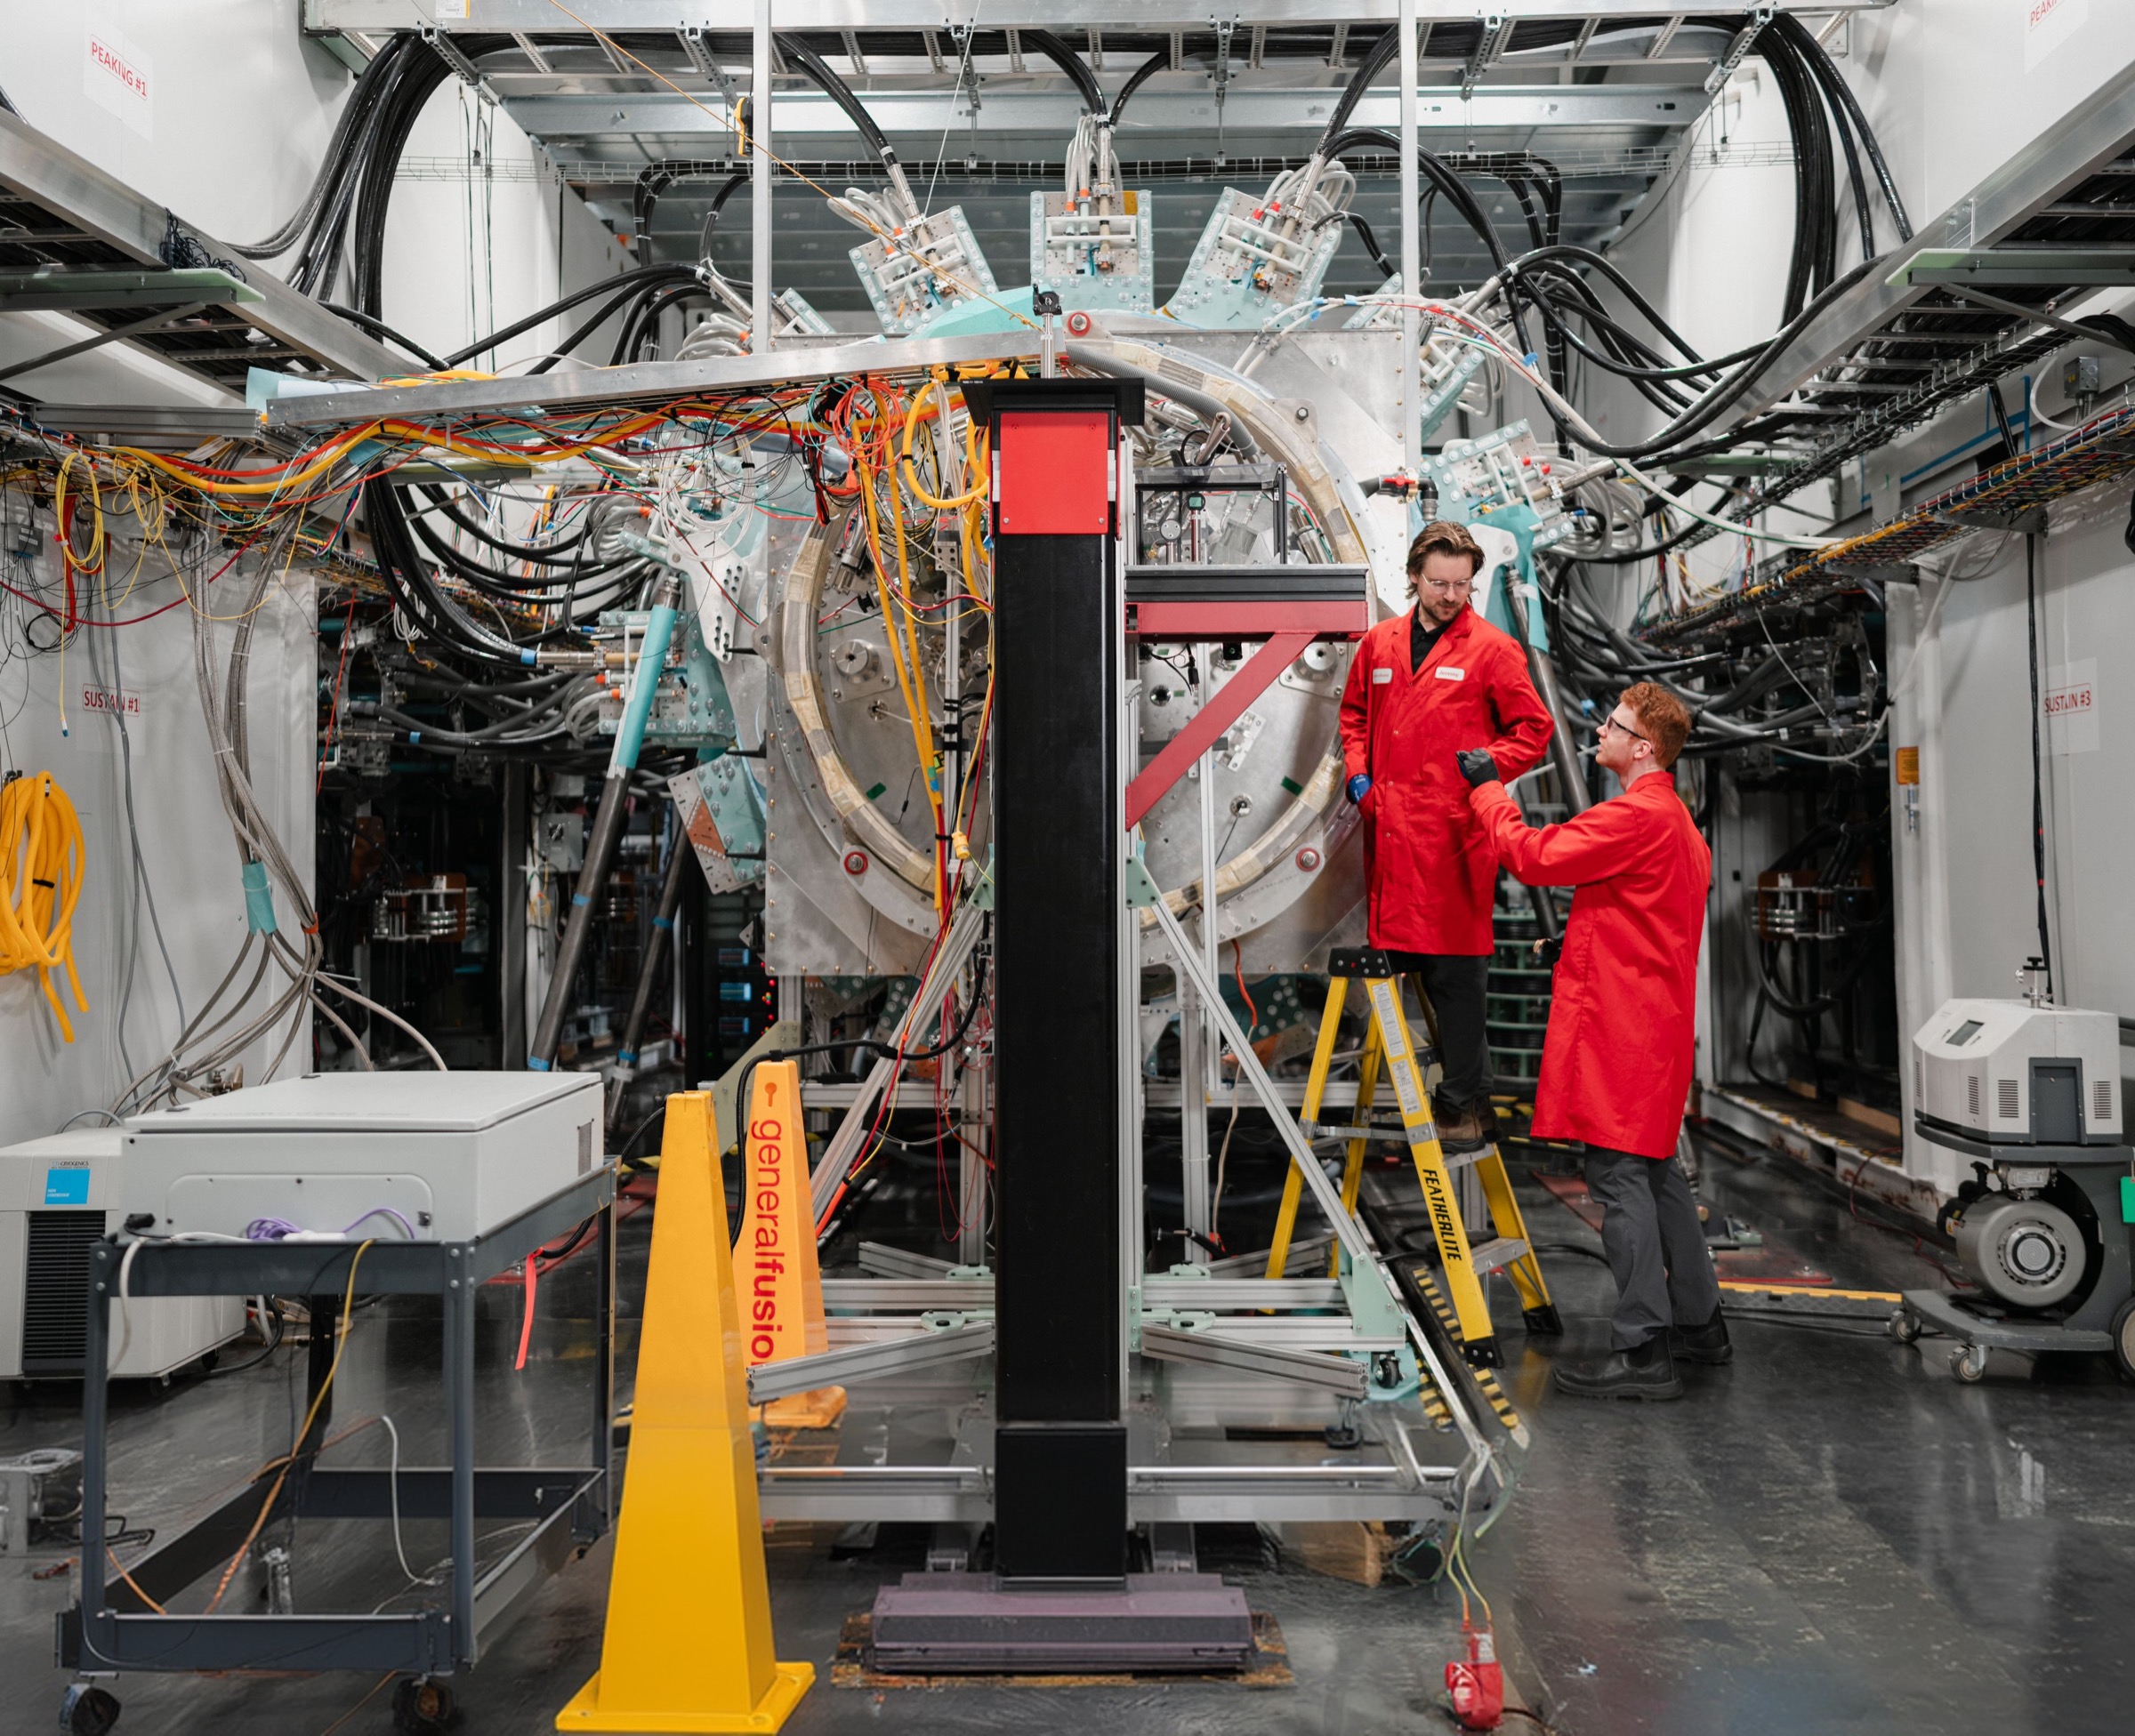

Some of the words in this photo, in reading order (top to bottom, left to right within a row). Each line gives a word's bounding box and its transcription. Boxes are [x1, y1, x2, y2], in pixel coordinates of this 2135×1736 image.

[92, 41, 133, 86] PEAKING
[135, 76, 147, 97] #1
[963, 234, 974, 249] TURN
[128, 697, 139, 712] #1
[2044, 694, 2078, 712] SUSTAIN
[2080, 690, 2091, 706] #3
[1422, 1169, 1462, 1261] FEATHERLITE
[751, 1119, 785, 1366] generalfusio
